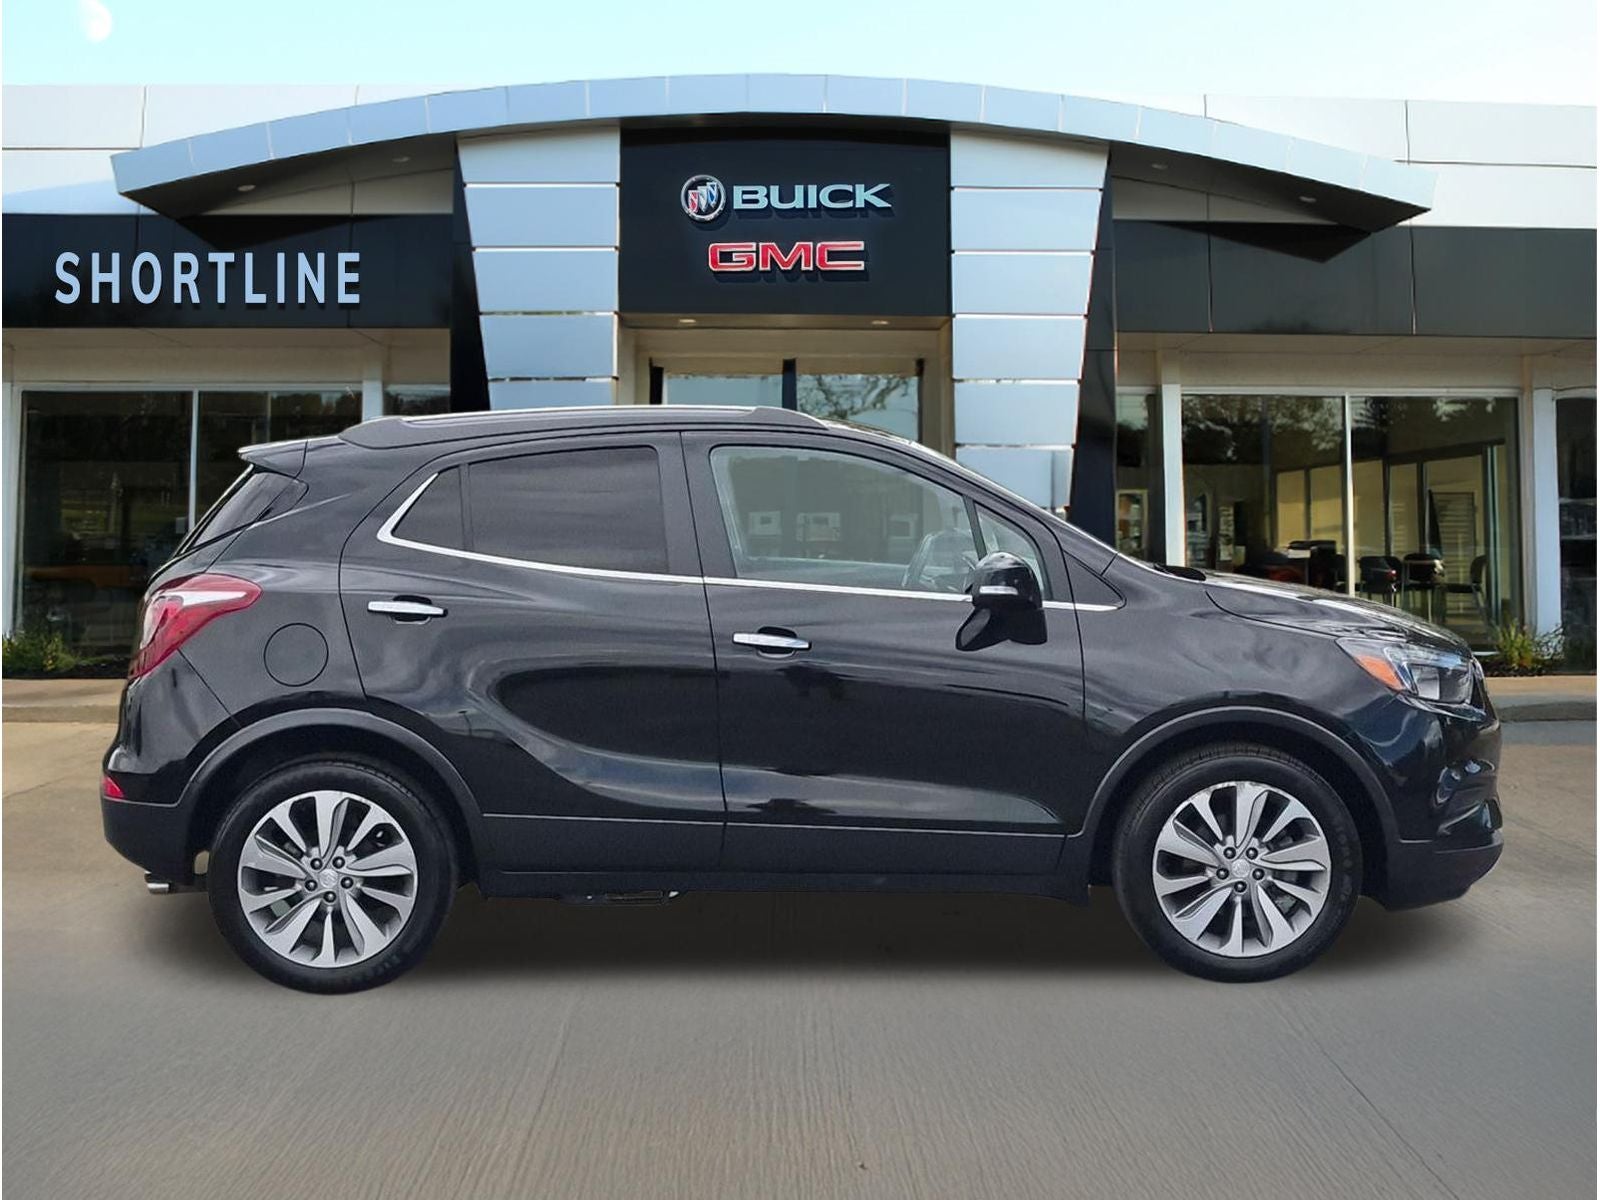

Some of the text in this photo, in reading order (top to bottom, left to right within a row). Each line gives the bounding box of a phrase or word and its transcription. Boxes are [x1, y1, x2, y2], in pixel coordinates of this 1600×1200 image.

[733, 183, 893, 210] BUICK
[708, 241, 865, 272] GMC
[55, 251, 361, 304] SHORTLINE
